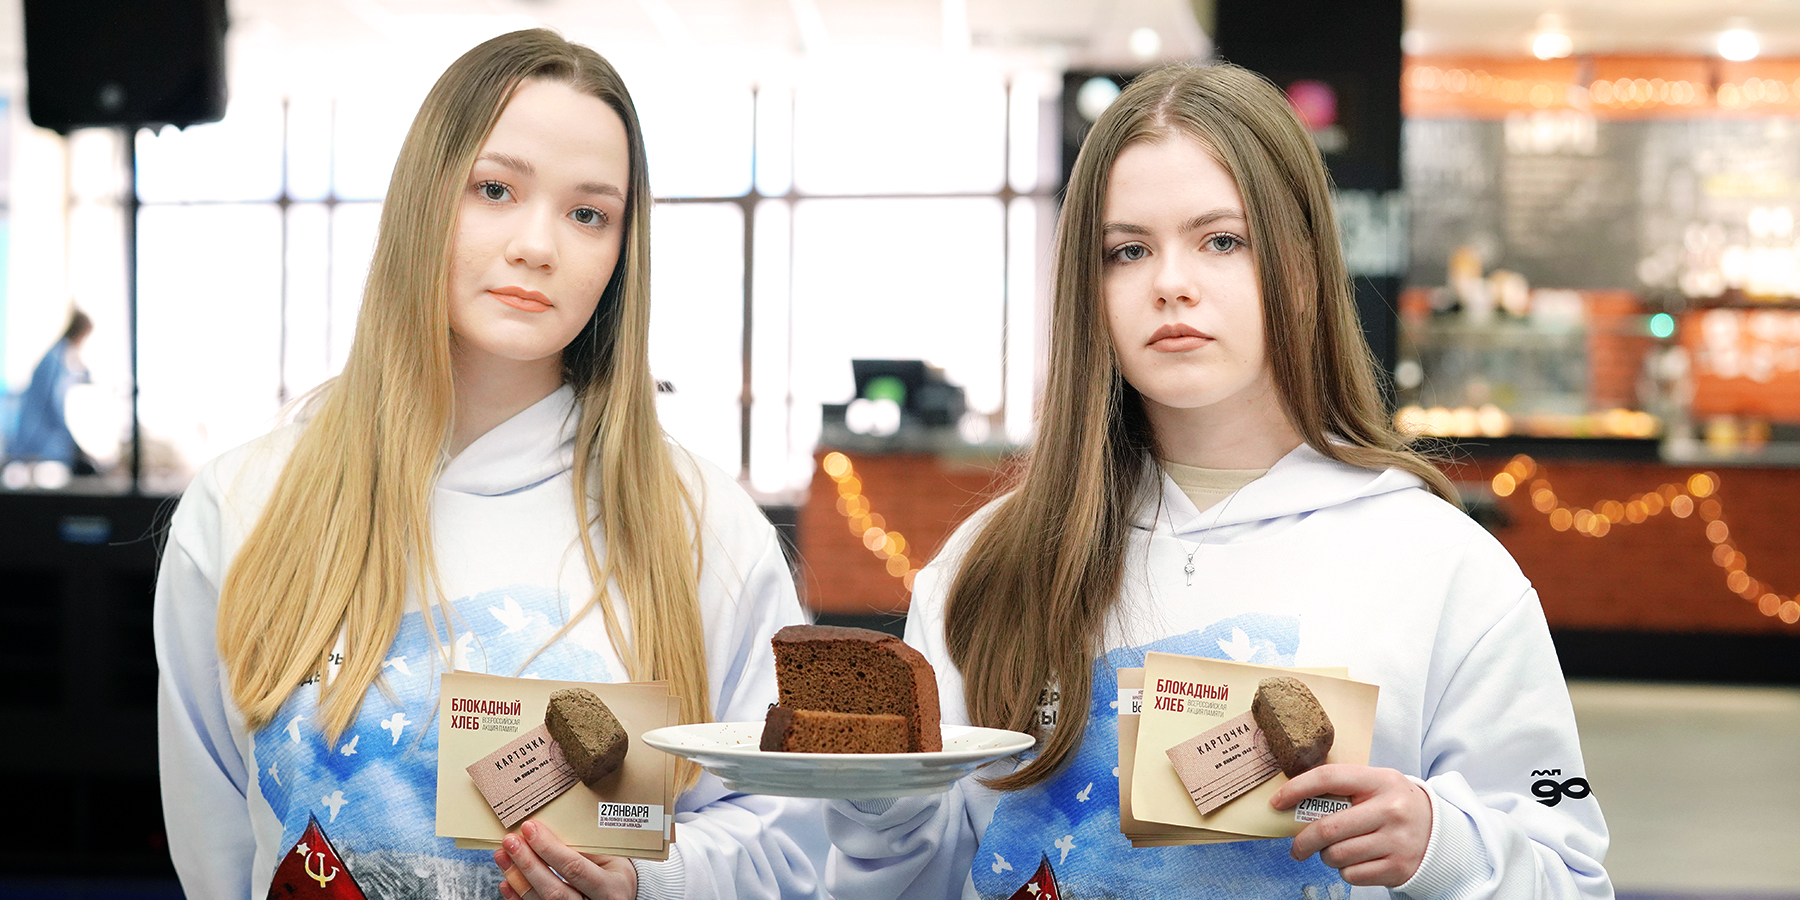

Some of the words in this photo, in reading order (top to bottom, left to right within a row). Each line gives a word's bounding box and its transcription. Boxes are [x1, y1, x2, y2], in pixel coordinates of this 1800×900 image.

[1156, 679, 1229, 701] БЛОКАДНЫЙ
[452, 698, 521, 716] БЛОКАДНЫЙ
[1154, 696, 1184, 712] ХЛЕБ
[451, 715, 479, 730] ХЛЕБ
[1196, 723, 1251, 755] КАРТОЧКА
[495, 736, 546, 770] КАРТОЧКА
